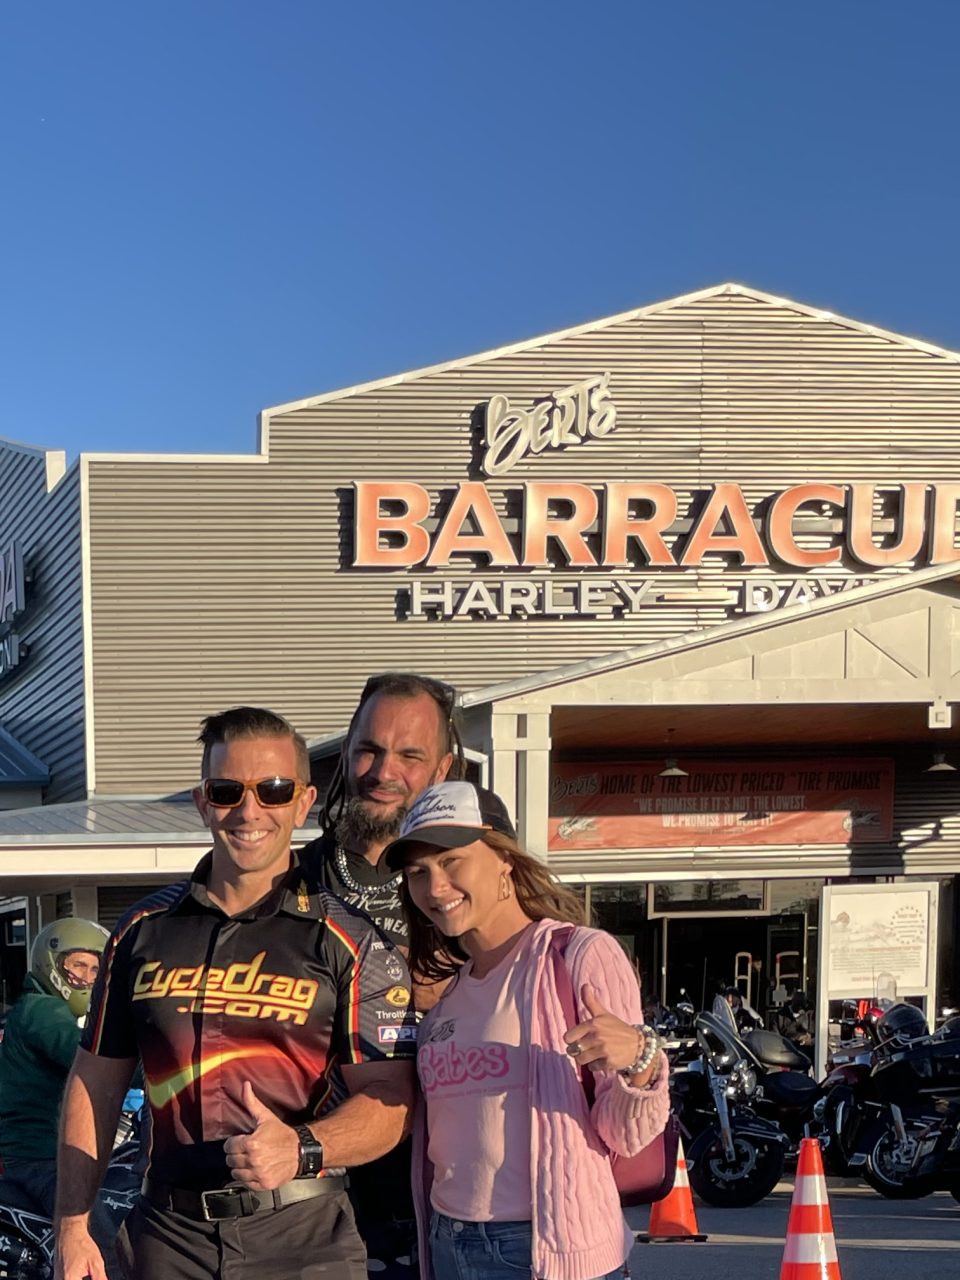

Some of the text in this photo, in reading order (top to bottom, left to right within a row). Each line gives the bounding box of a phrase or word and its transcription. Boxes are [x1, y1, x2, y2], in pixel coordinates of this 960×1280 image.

[600, 775, 637, 794] HOME
[641, 775, 657, 794] OF
[662, 774, 685, 793] THE
[687, 773, 736, 793] LOWEST
[740, 772, 785, 792] PRICED
[732, 796, 751, 810] NOT
[753, 796, 769, 810] THE
[383, 917, 408, 937] WEA
